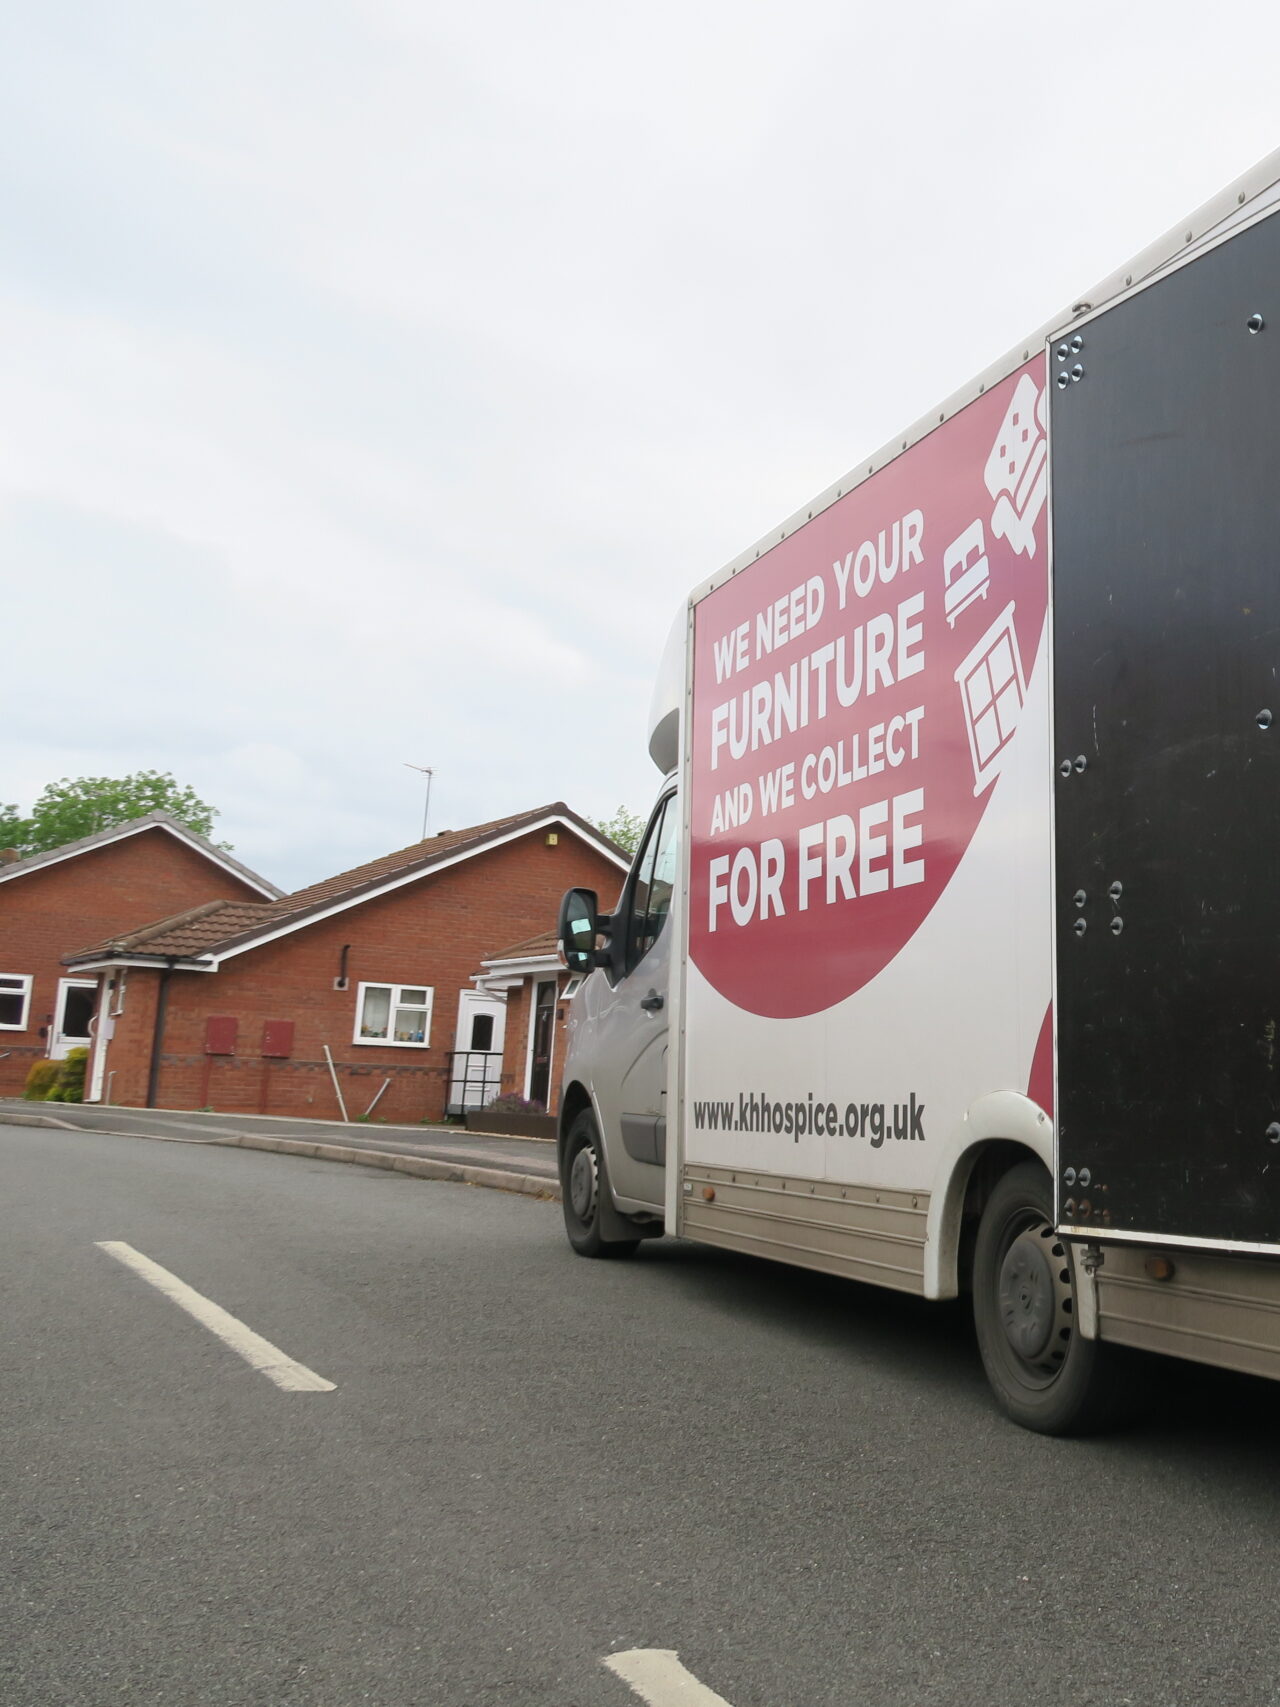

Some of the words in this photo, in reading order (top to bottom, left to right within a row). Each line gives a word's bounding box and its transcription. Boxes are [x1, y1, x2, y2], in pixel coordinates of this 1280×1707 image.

[713, 620, 750, 685] WE
[755, 575, 825, 661] NEED
[833, 509, 925, 610] YOUR
[711, 591, 925, 771] FURNITURE
[709, 781, 753, 836] AND
[758, 761, 795, 816] WE
[800, 704, 925, 800] COLLECT
[708, 838, 786, 933] FOR
[799, 787, 925, 912] FREE
[694, 1092, 925, 1148] www.khhospice.org.uk
